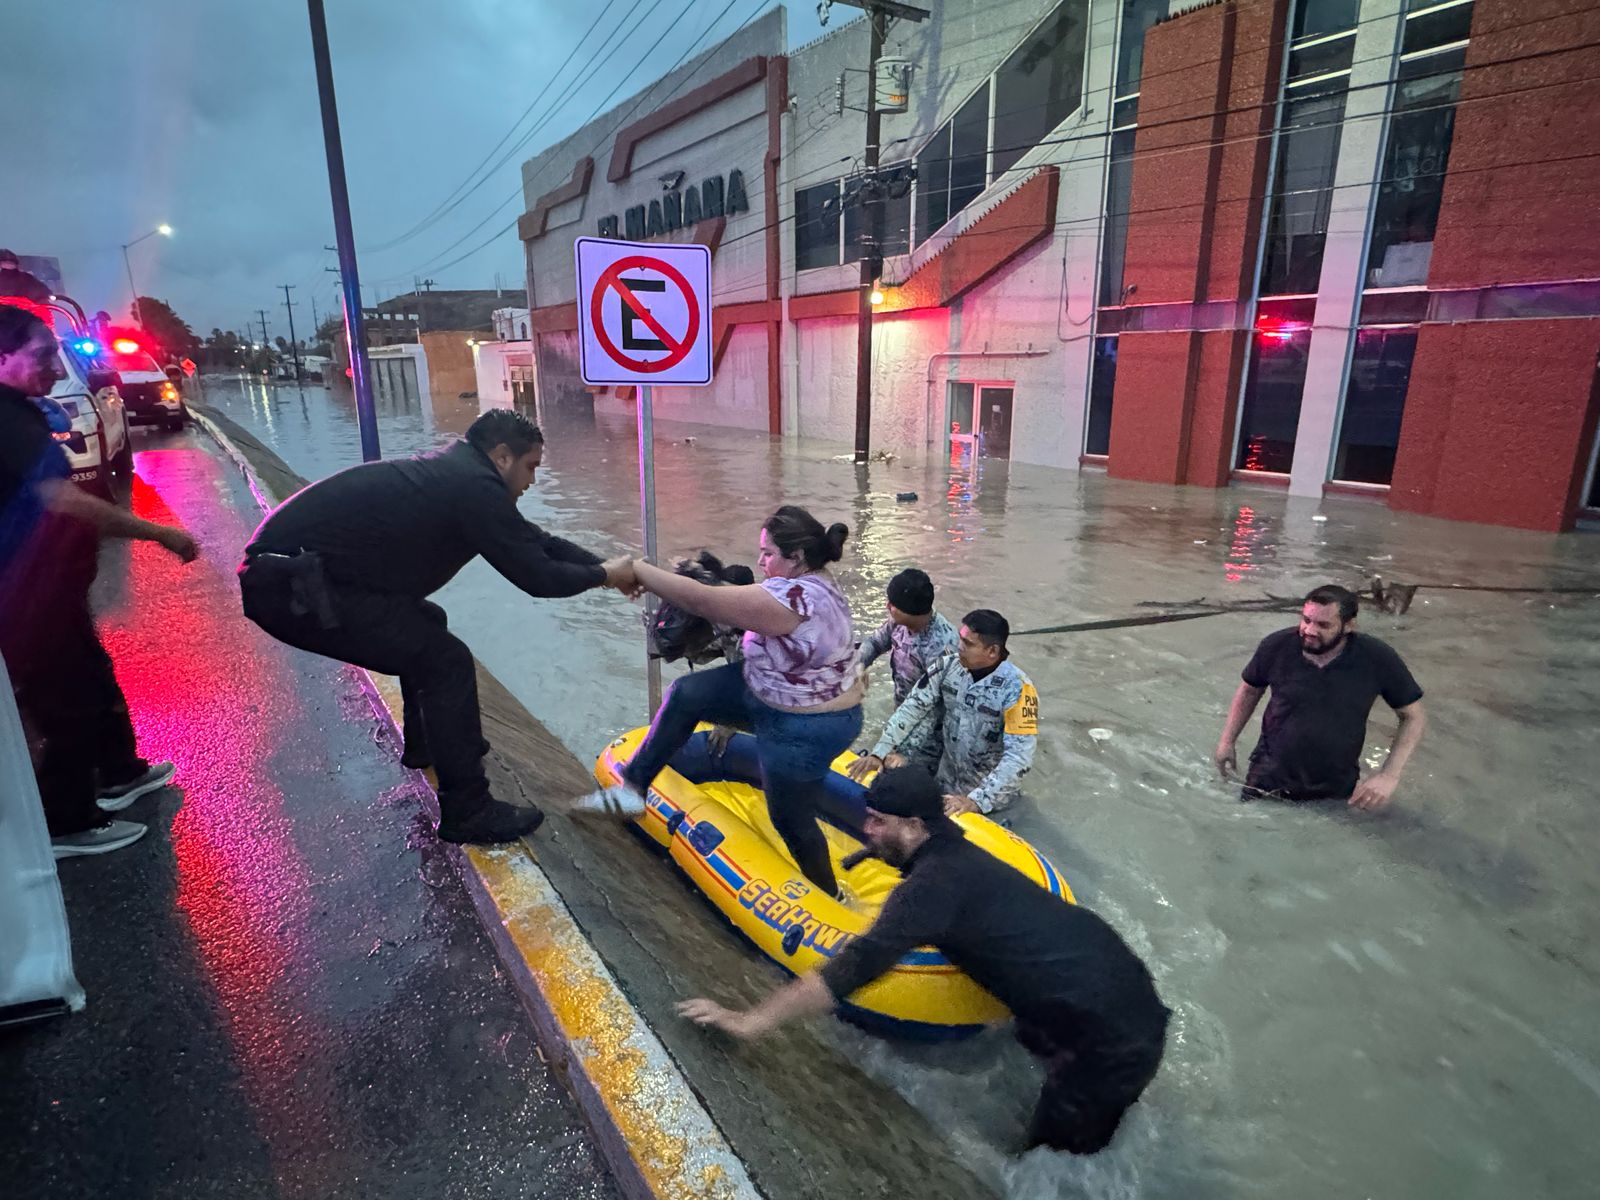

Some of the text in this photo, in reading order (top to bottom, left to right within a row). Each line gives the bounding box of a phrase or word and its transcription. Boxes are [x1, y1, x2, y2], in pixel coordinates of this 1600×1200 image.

[625, 168, 749, 240] MAÑANA
[620, 278, 670, 351] E
[738, 878, 857, 957] SEAHAW
